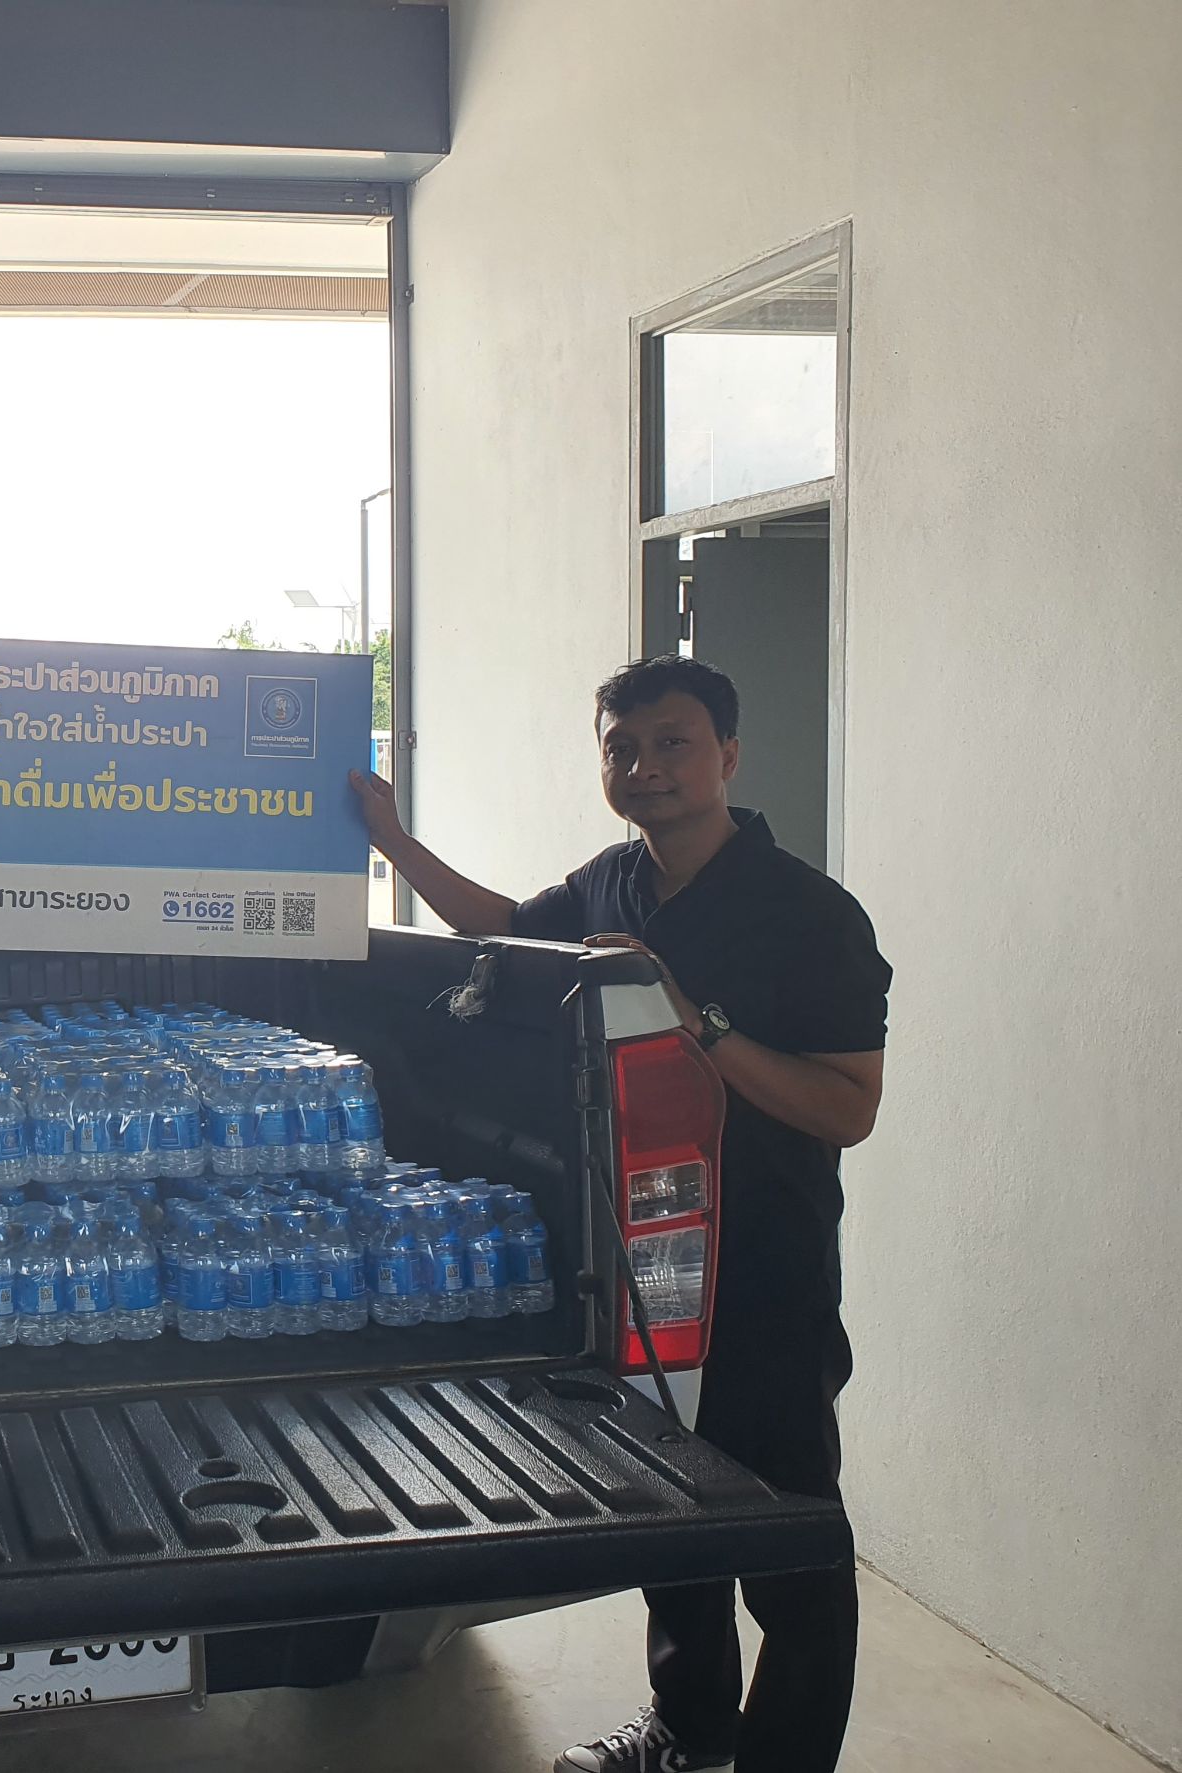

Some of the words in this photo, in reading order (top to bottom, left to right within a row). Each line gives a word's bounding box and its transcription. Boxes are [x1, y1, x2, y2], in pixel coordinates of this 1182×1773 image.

[182, 891, 209, 899] Contact
[182, 900, 235, 919] 1662
[13, 1686, 93, 1711] ระยอง
